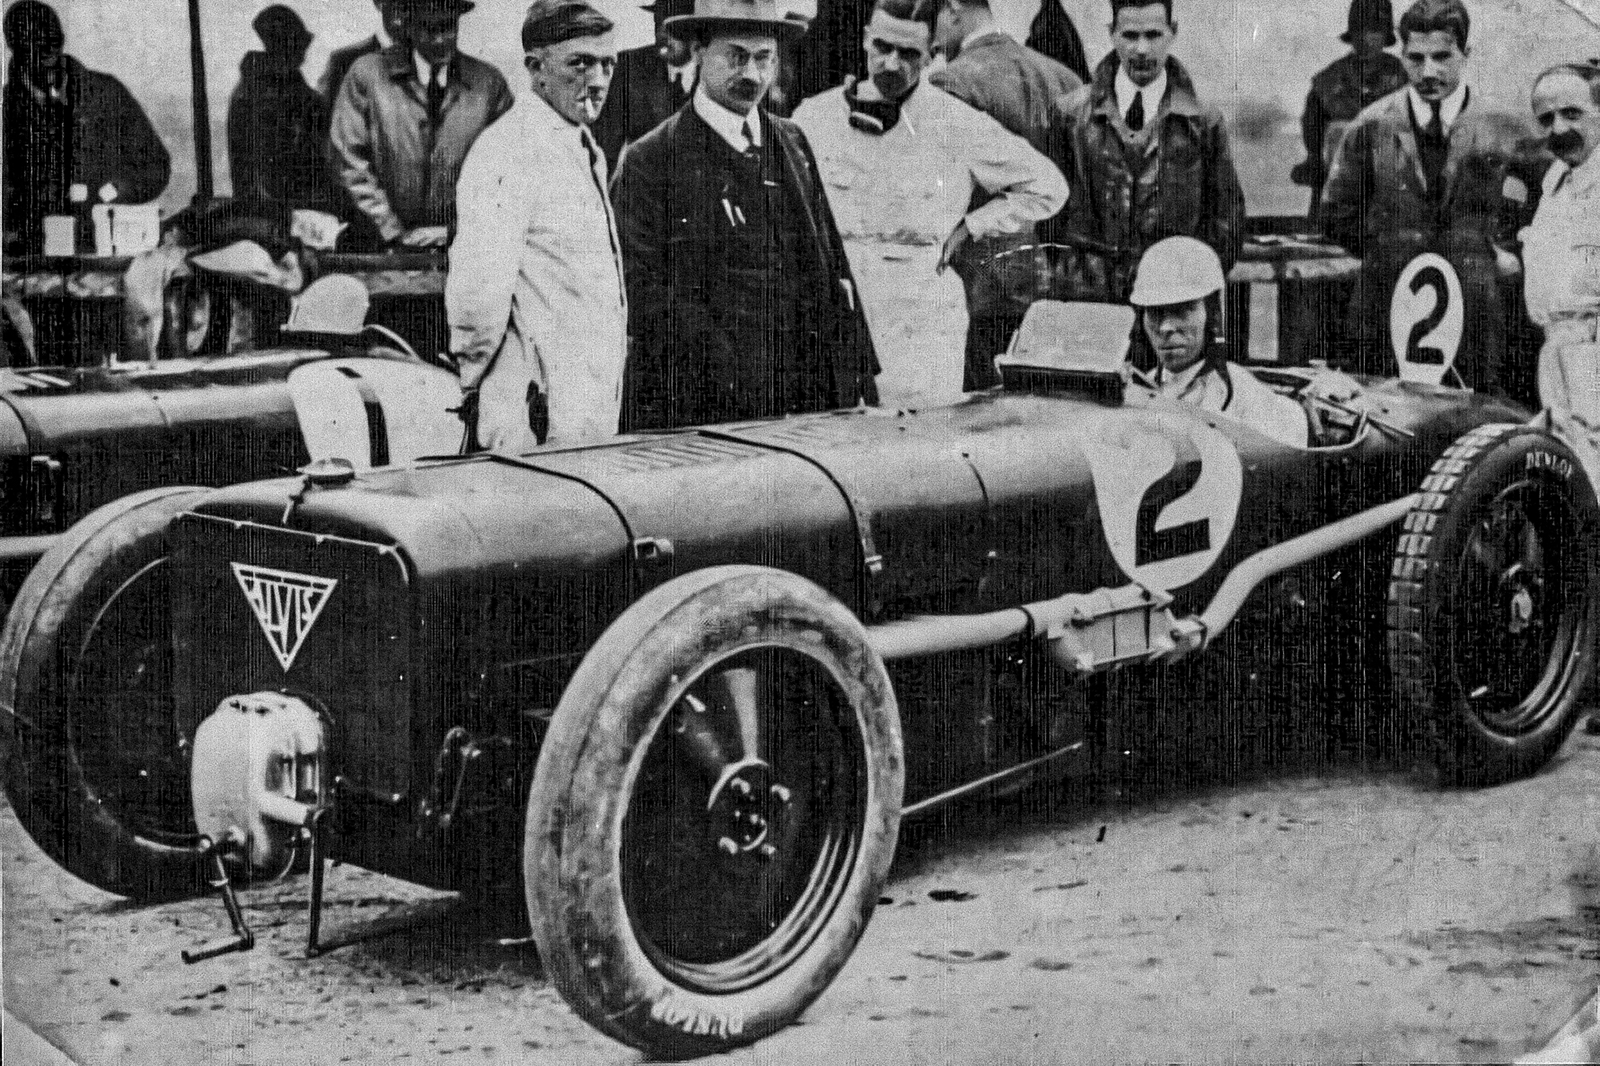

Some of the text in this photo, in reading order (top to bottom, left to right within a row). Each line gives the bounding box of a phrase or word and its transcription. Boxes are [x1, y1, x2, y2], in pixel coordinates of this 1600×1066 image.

[1405, 265, 1449, 365] 2
[1120, 424, 1211, 569] 2
[241, 574, 327, 656] ALVIS
